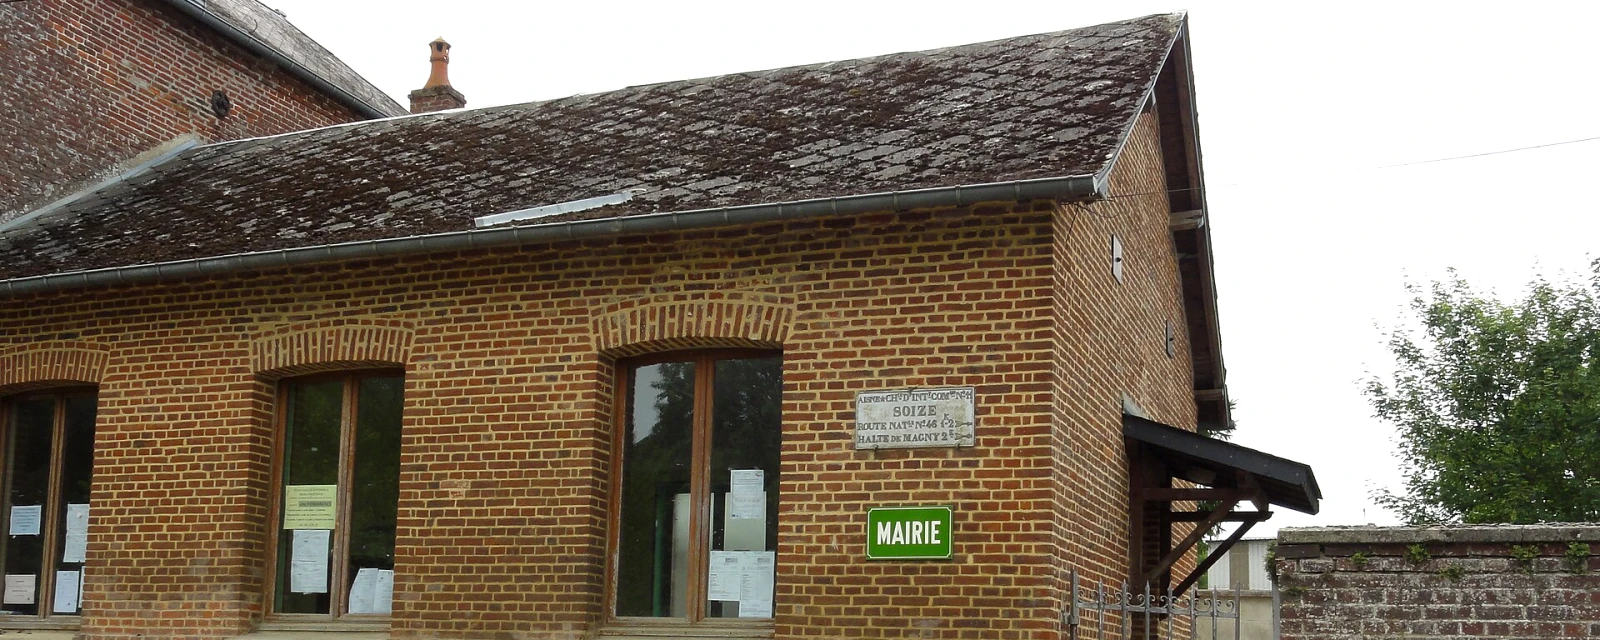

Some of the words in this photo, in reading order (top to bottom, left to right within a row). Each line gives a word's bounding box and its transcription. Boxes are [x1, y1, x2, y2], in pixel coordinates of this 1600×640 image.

[893, 405, 937, 417] SOIZE
[858, 422, 887, 431] ROUTE
[859, 435, 889, 444] HALTE
[877, 520, 941, 545] MAIRIE
